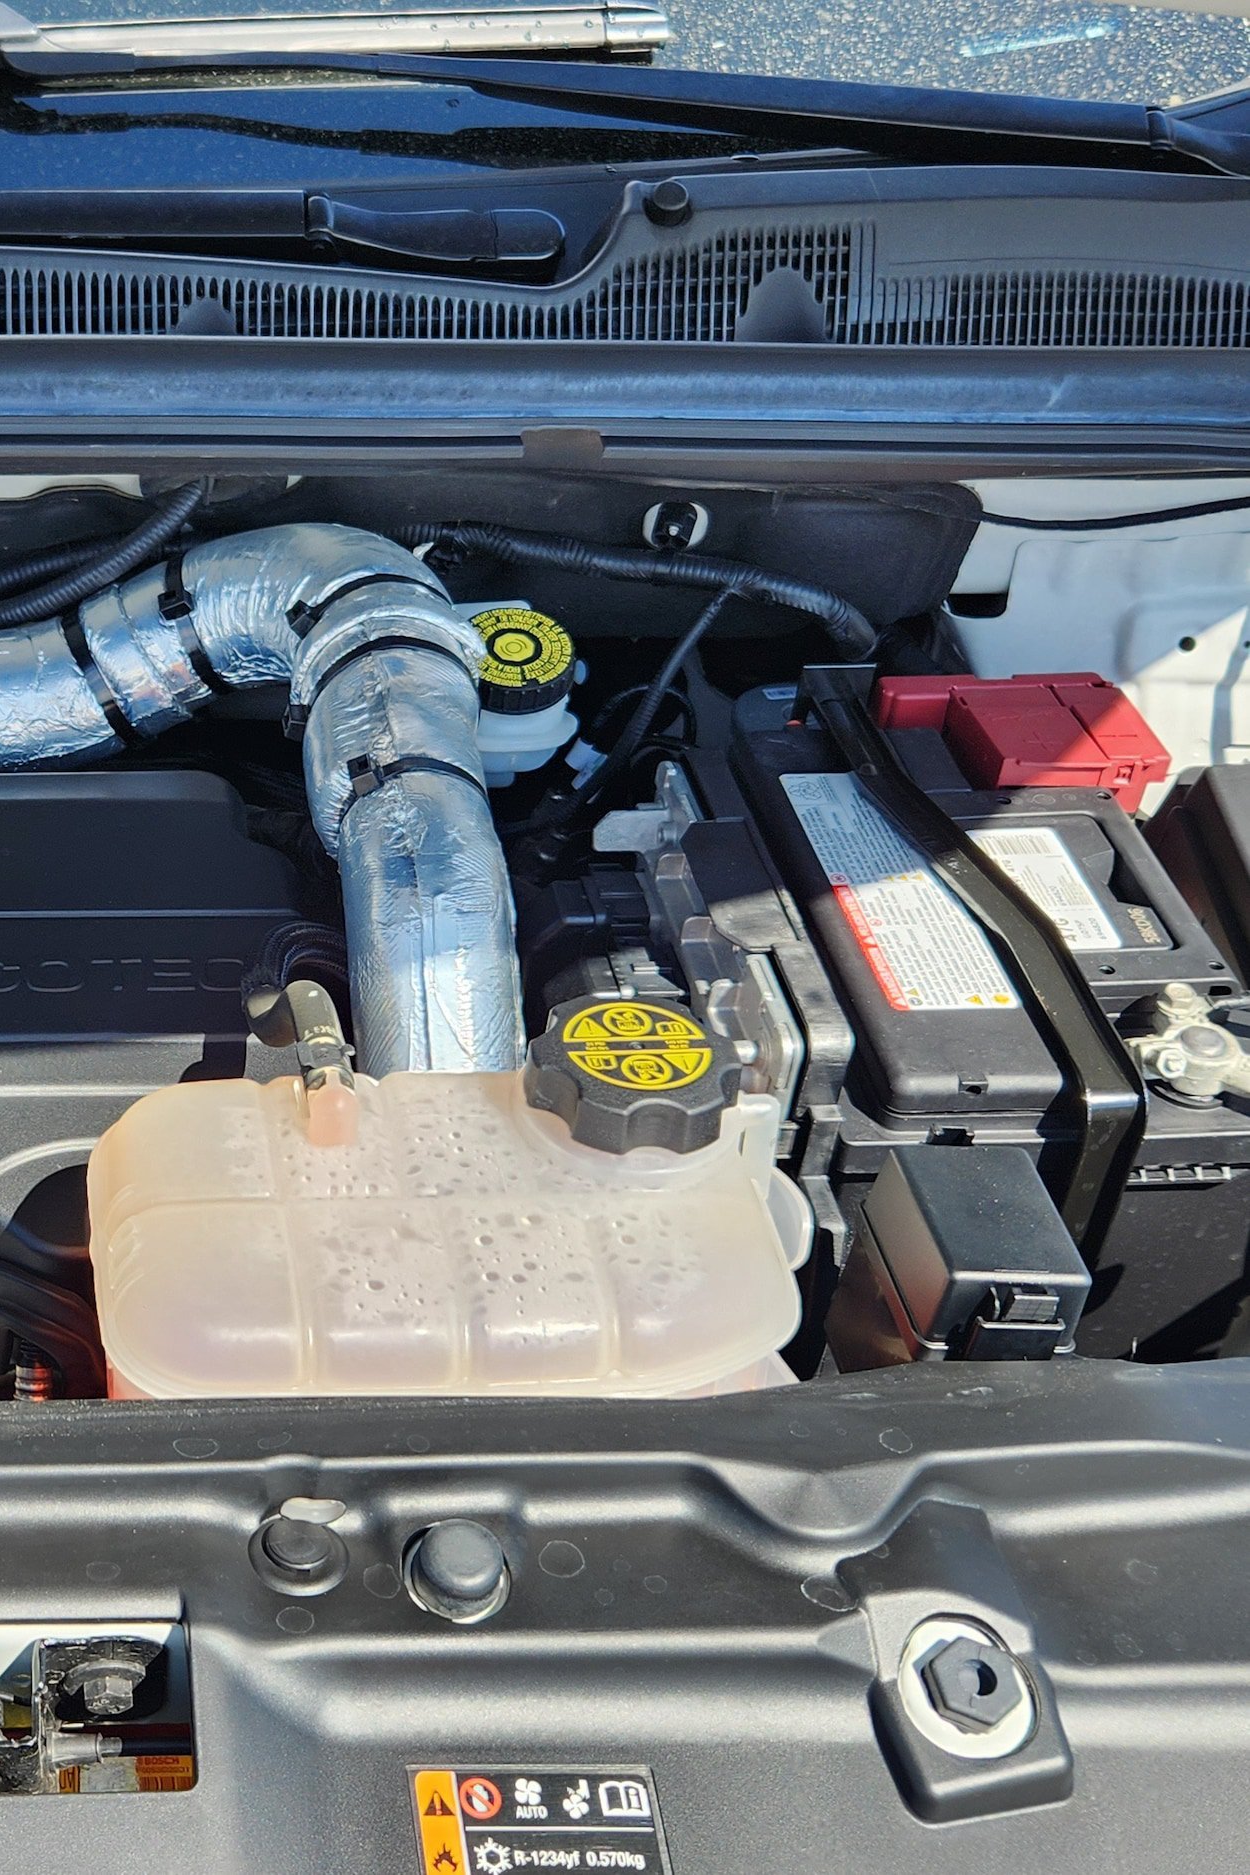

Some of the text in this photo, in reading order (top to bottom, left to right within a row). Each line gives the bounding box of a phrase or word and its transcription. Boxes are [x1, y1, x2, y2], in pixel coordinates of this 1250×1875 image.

[516, 1805, 548, 1819] AUTO
[514, 1850, 646, 1870] R-1234yf 0.570kg
